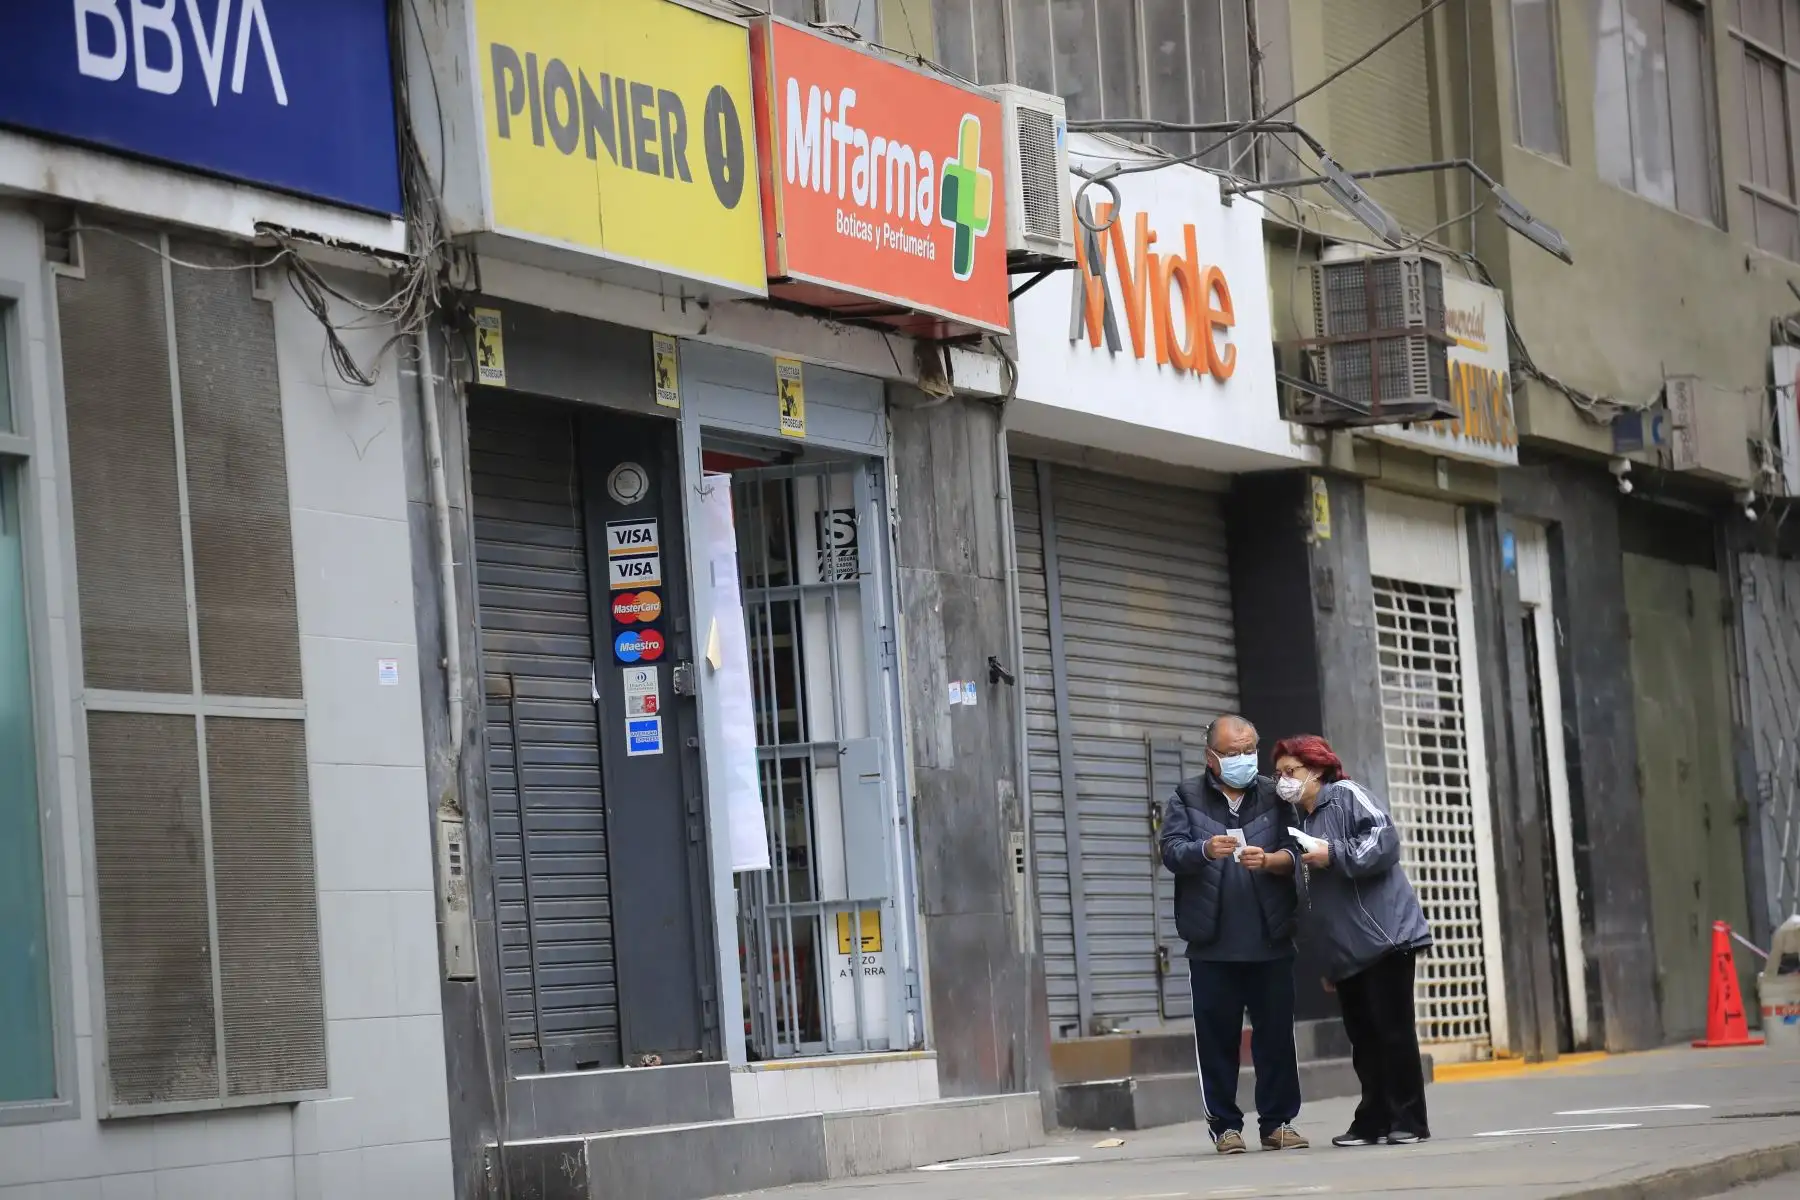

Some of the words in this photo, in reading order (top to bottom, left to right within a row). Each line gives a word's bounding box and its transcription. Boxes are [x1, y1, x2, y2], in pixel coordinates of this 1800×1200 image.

[74, 0, 288, 107] BBVA
[490, 43, 692, 184] PIONIER
[786, 77, 934, 226] Mifarma
[836, 208, 873, 242] Boticas
[875, 226, 881, 251] y
[883, 222, 935, 260] Perfumería
[1403, 260, 1421, 315] YORK
[480, 368, 504, 379] PROSEGUR
[658, 389, 678, 402] PROSEGUR
[782, 417, 804, 429] PROSEGUR
[613, 528, 652, 544] VISA
[616, 562, 653, 577] VISA
[614, 602, 661, 614] MasterCard
[620, 641, 660, 651] Maestro
[848, 956, 876, 965] PZO
[840, 969, 847, 977] A
[850, 967, 886, 976] TRRA
